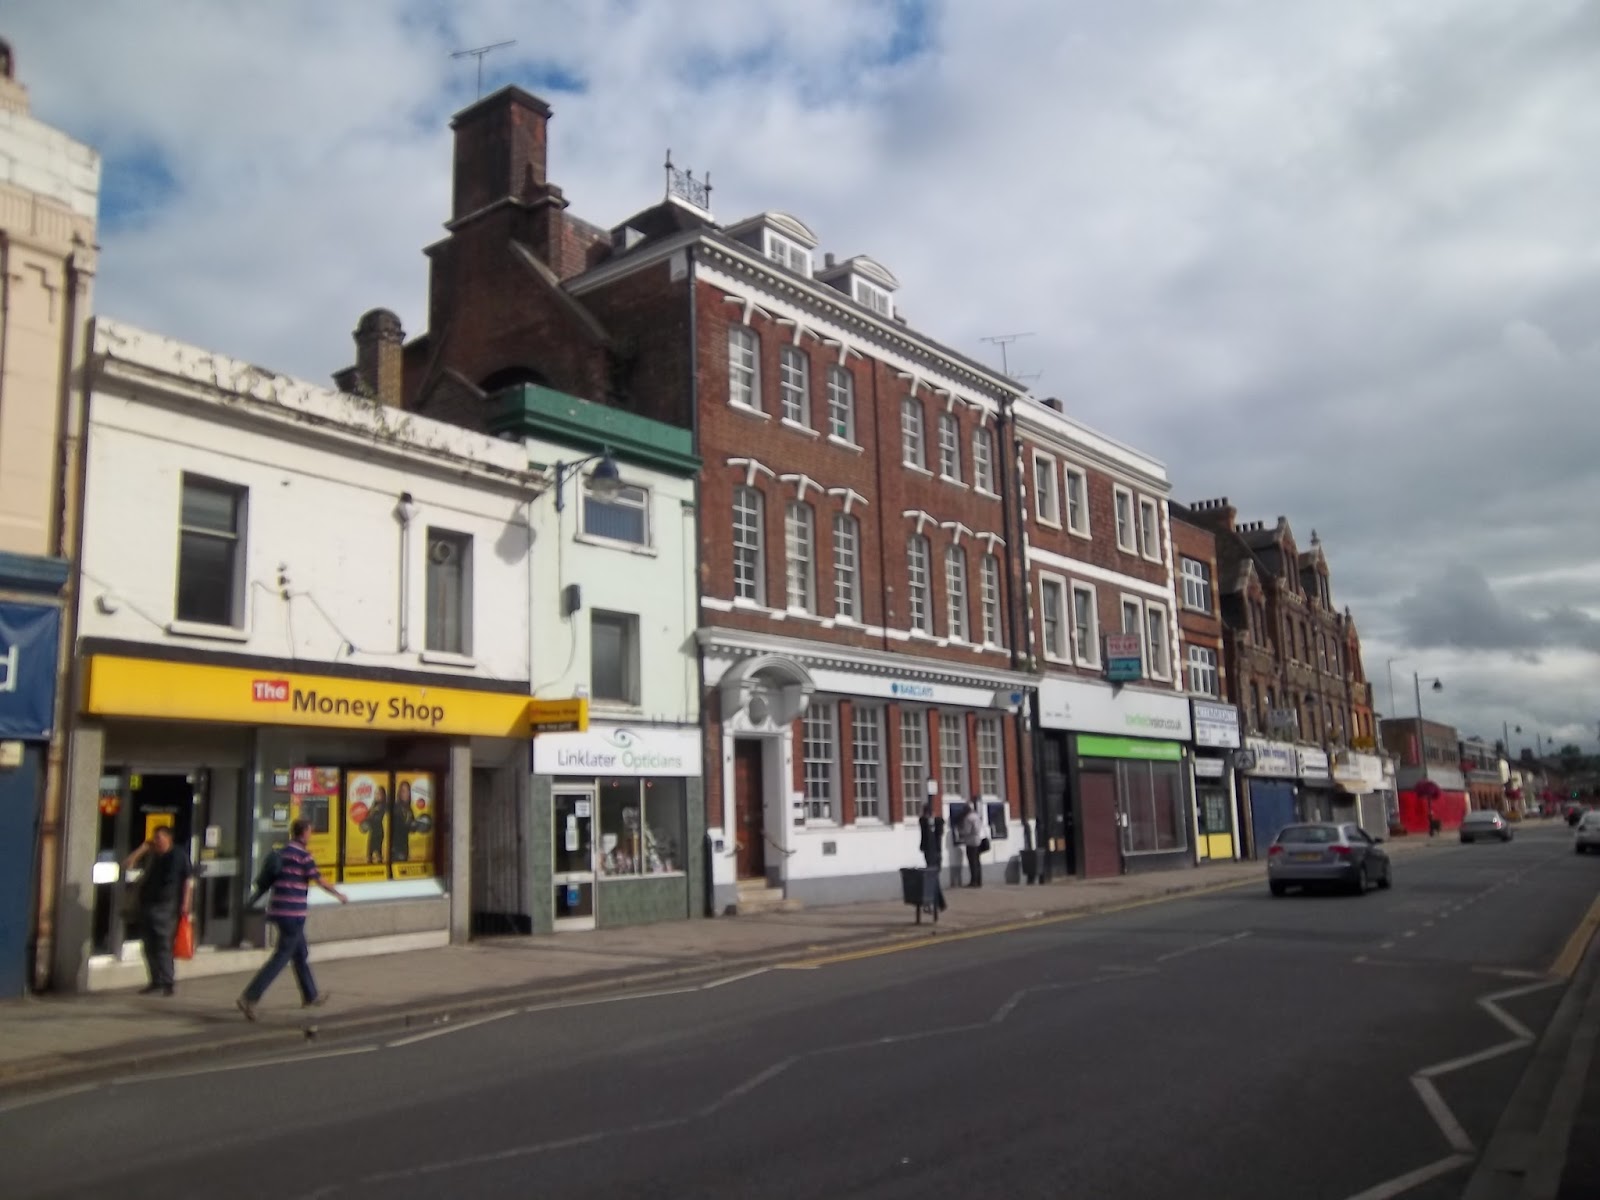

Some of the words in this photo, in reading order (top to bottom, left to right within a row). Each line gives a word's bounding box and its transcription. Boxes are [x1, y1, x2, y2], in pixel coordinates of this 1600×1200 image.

[900, 684, 934, 697] BARCLAYS
[254, 682, 286, 700] The
[292, 689, 380, 723] Money
[388, 696, 445, 727] Shop
[557, 749, 617, 768] Linklater
[621, 751, 682, 771] Opticians
